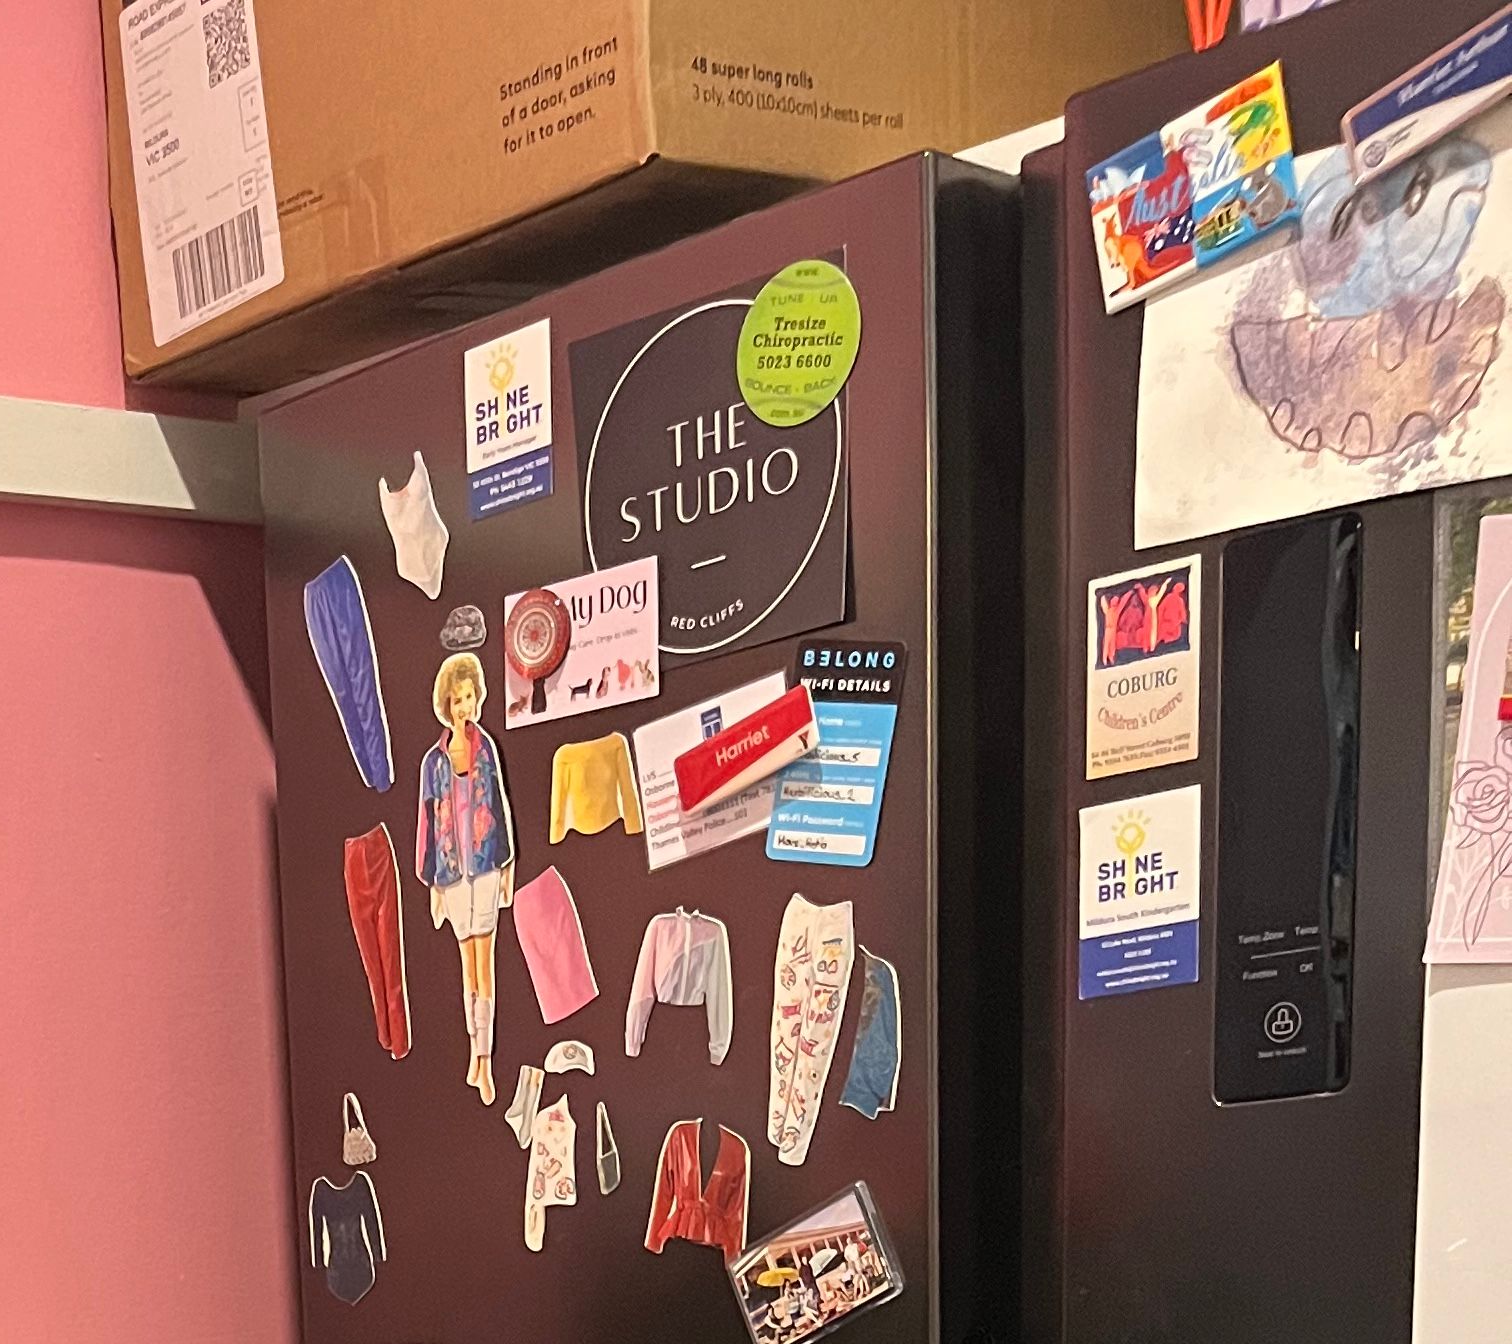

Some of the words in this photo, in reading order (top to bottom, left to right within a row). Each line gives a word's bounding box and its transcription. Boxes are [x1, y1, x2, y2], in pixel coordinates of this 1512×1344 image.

[499, 60, 563, 102] Standing
[566, 53, 579, 71] in
[582, 37, 619, 67] front
[691, 56, 708, 75] 48
[711, 62, 751, 82] super
[752, 65, 783, 88] long
[785, 70, 814, 90] rolls
[501, 112, 516, 130] of
[519, 108, 528, 121] a
[531, 90, 569, 115] door,
[569, 67, 617, 99] asking
[692, 84, 701, 102] 3
[728, 88, 754, 108] 400
[757, 92, 818, 119] (10x10cm)
[820, 104, 860, 124] sheets
[862, 110, 884, 130] per
[885, 110, 904, 130] roll
[503, 137, 523, 155] for
[525, 130, 538, 147] it
[540, 125, 554, 139] to
[557, 107, 596, 138] open.
[753, 331, 844, 351] Chiropractic
[774, 316, 827, 332] Tresize
[757, 355, 791, 370] 5023
[796, 354, 832, 369] 6600
[666, 402, 747, 467] THE
[619, 447, 799, 543] STUDIO
[600, 579, 648, 614] Dog
[670, 615, 696, 631] RED
[699, 598, 745, 630] CLIFFS
[800, 677, 835, 692] WI-FI
[837, 679, 892, 693] DETAILS
[1107, 667, 1178, 699] COBURG
[1097, 706, 1148, 731] Children's
[714, 724, 771, 768] Harriet
